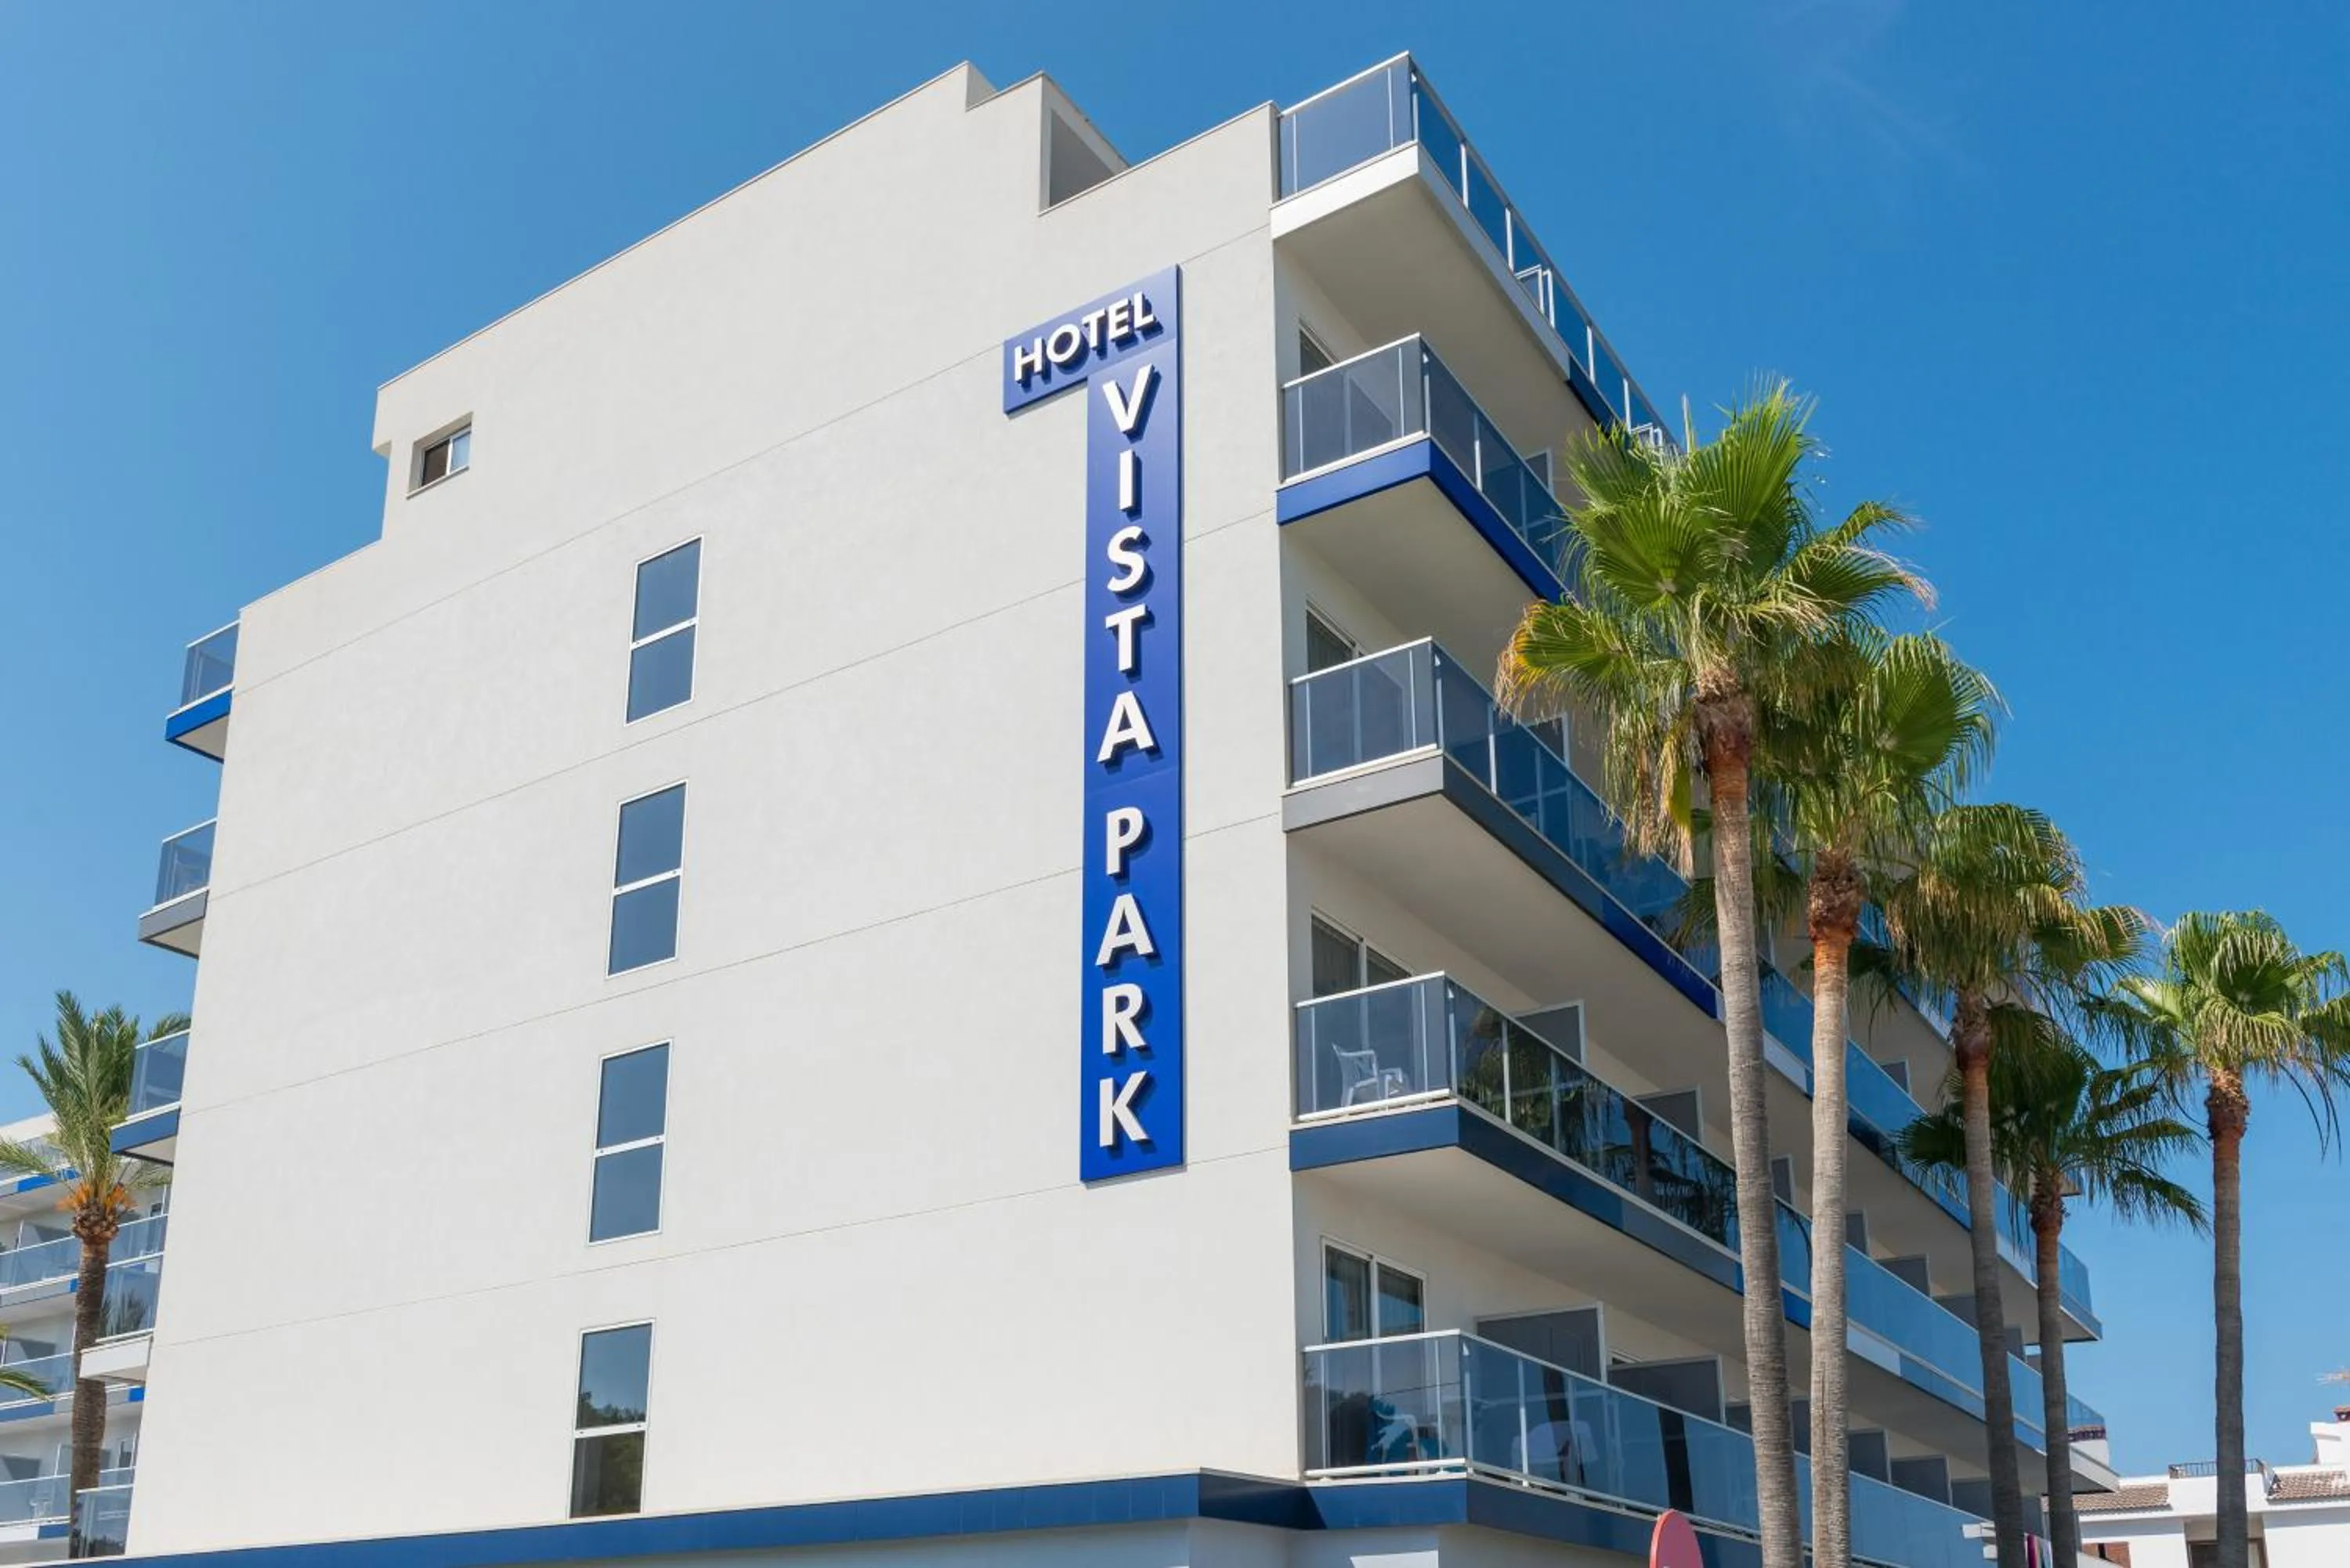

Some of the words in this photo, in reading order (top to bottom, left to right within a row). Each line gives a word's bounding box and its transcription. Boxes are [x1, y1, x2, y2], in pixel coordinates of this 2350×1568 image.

[1014, 291, 1155, 382] HOTEL
[1097, 363, 1155, 763] VISTA
[1095, 806, 1155, 1147] PARK
